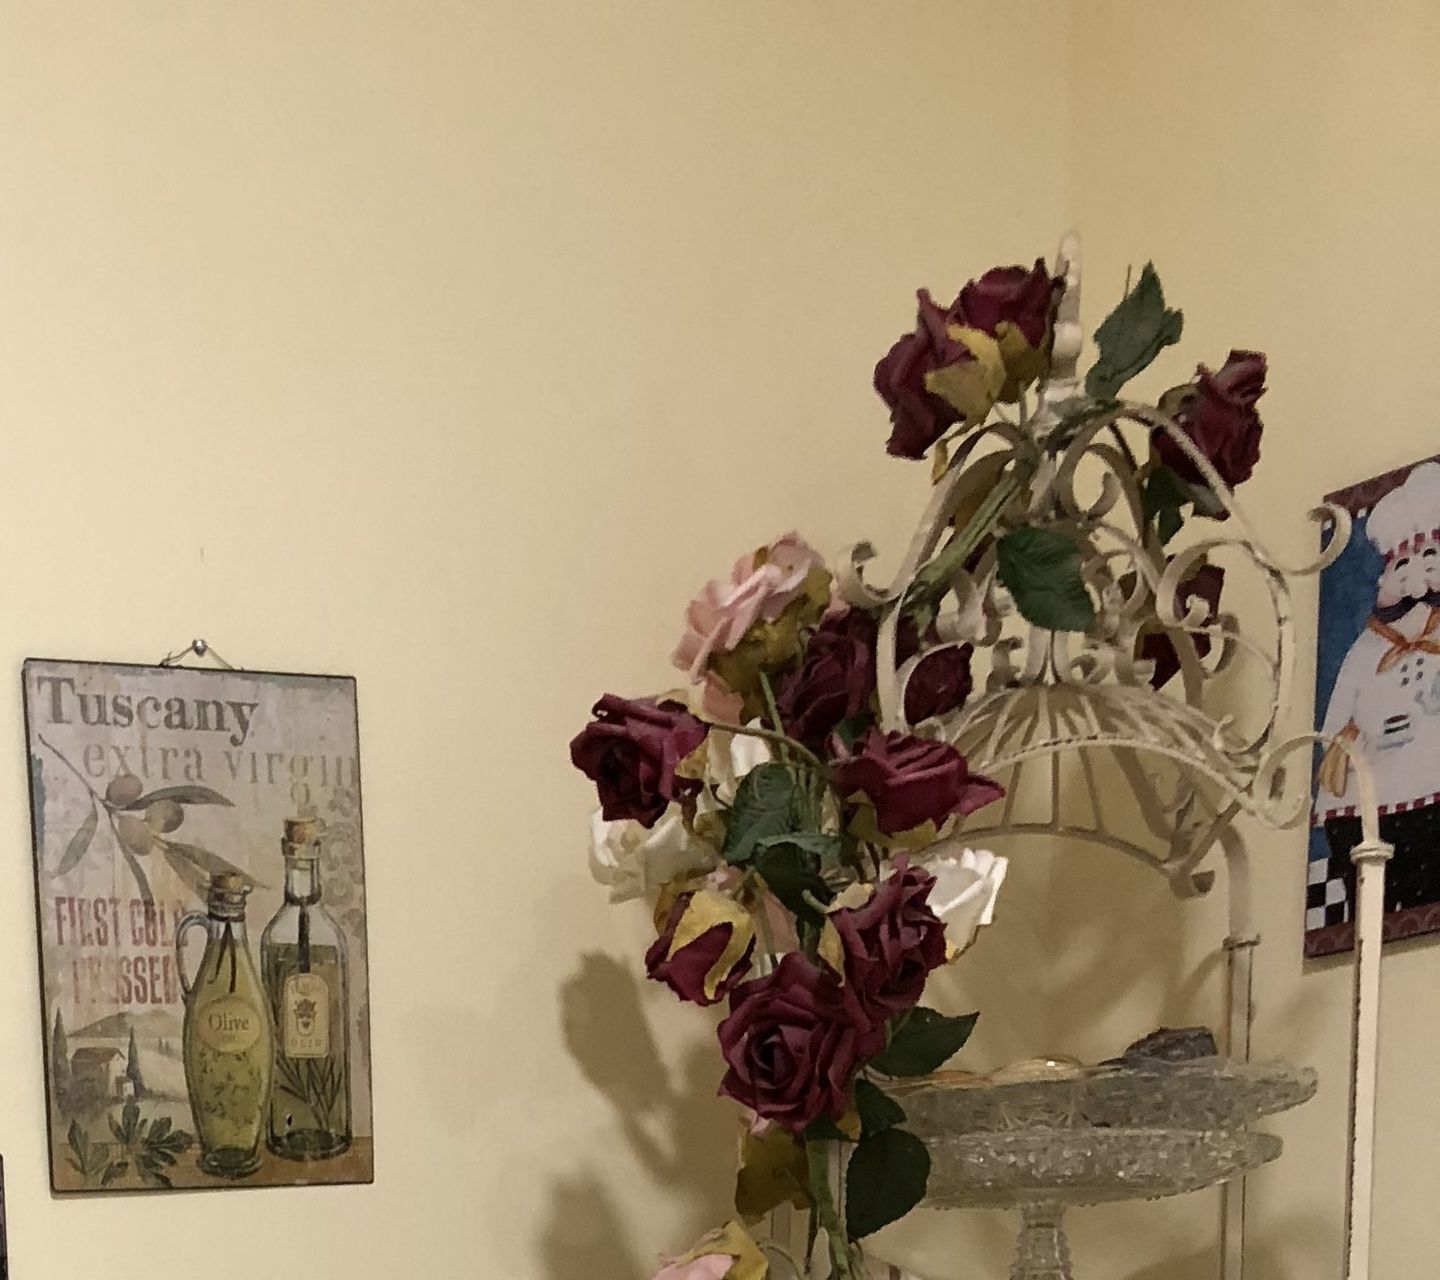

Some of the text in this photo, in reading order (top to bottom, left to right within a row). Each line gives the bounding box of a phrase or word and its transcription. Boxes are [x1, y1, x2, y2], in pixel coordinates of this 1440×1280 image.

[37, 675, 259, 748] Tuscany
[82, 741, 206, 782] extra
[55, 896, 121, 947] FIRST
[208, 1011, 250, 1031] Olive
